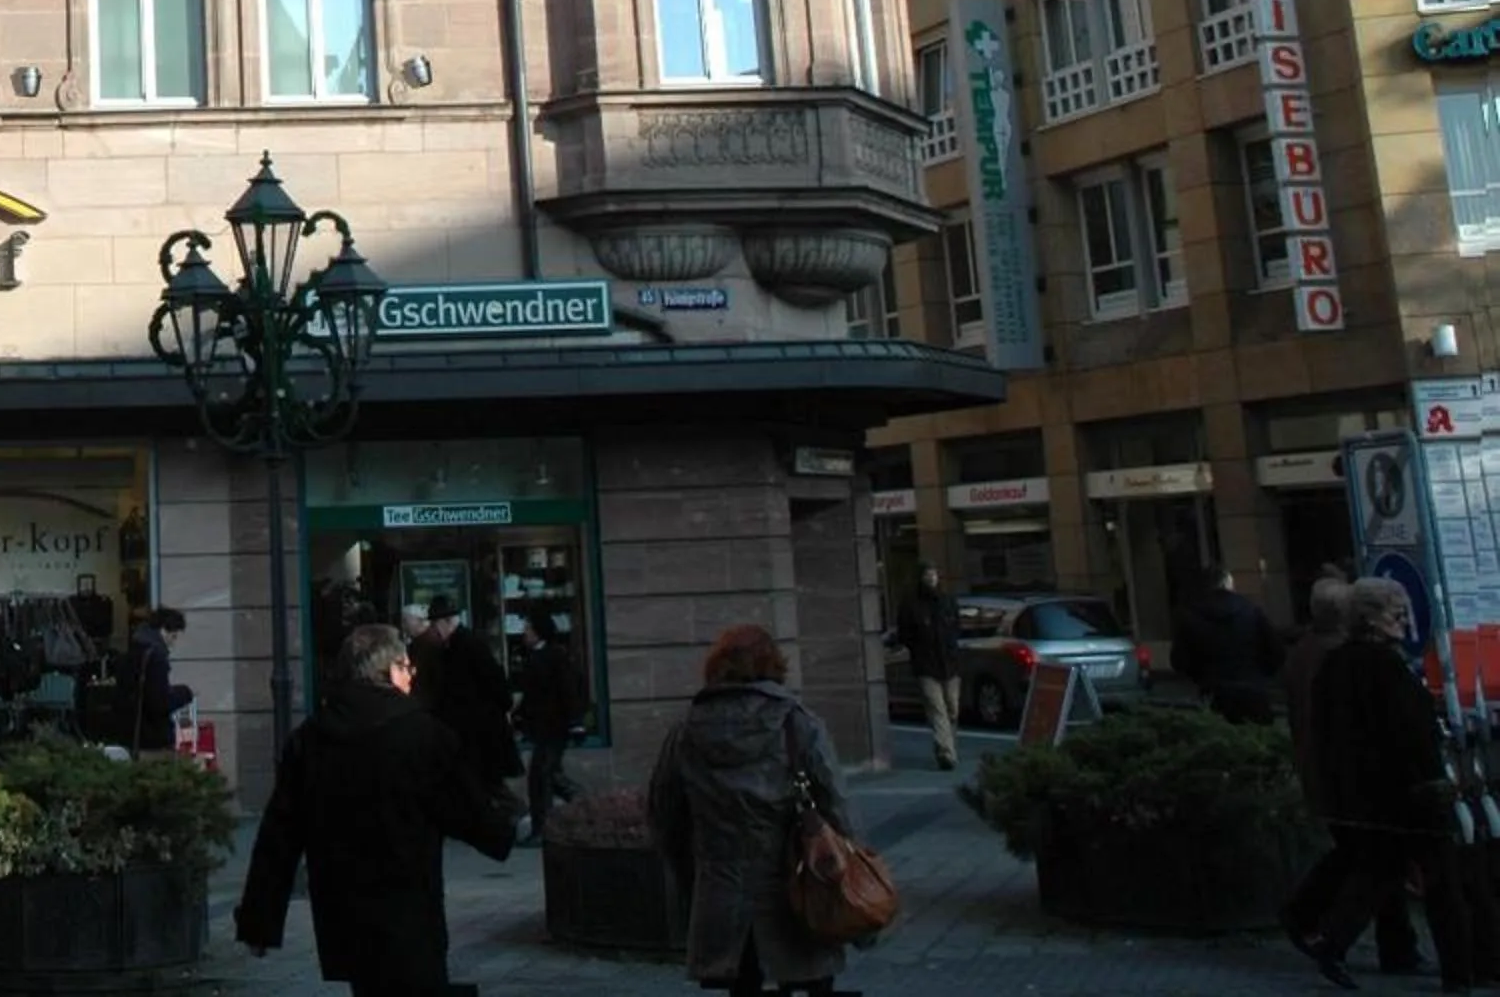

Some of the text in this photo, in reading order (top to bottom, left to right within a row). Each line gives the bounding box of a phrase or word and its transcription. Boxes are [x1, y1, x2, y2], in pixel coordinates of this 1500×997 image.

[968, 71, 1005, 202] TEMPUR
[378, 291, 598, 329] Gschwendner
[386, 504, 509, 524] Tee Gschwendner
